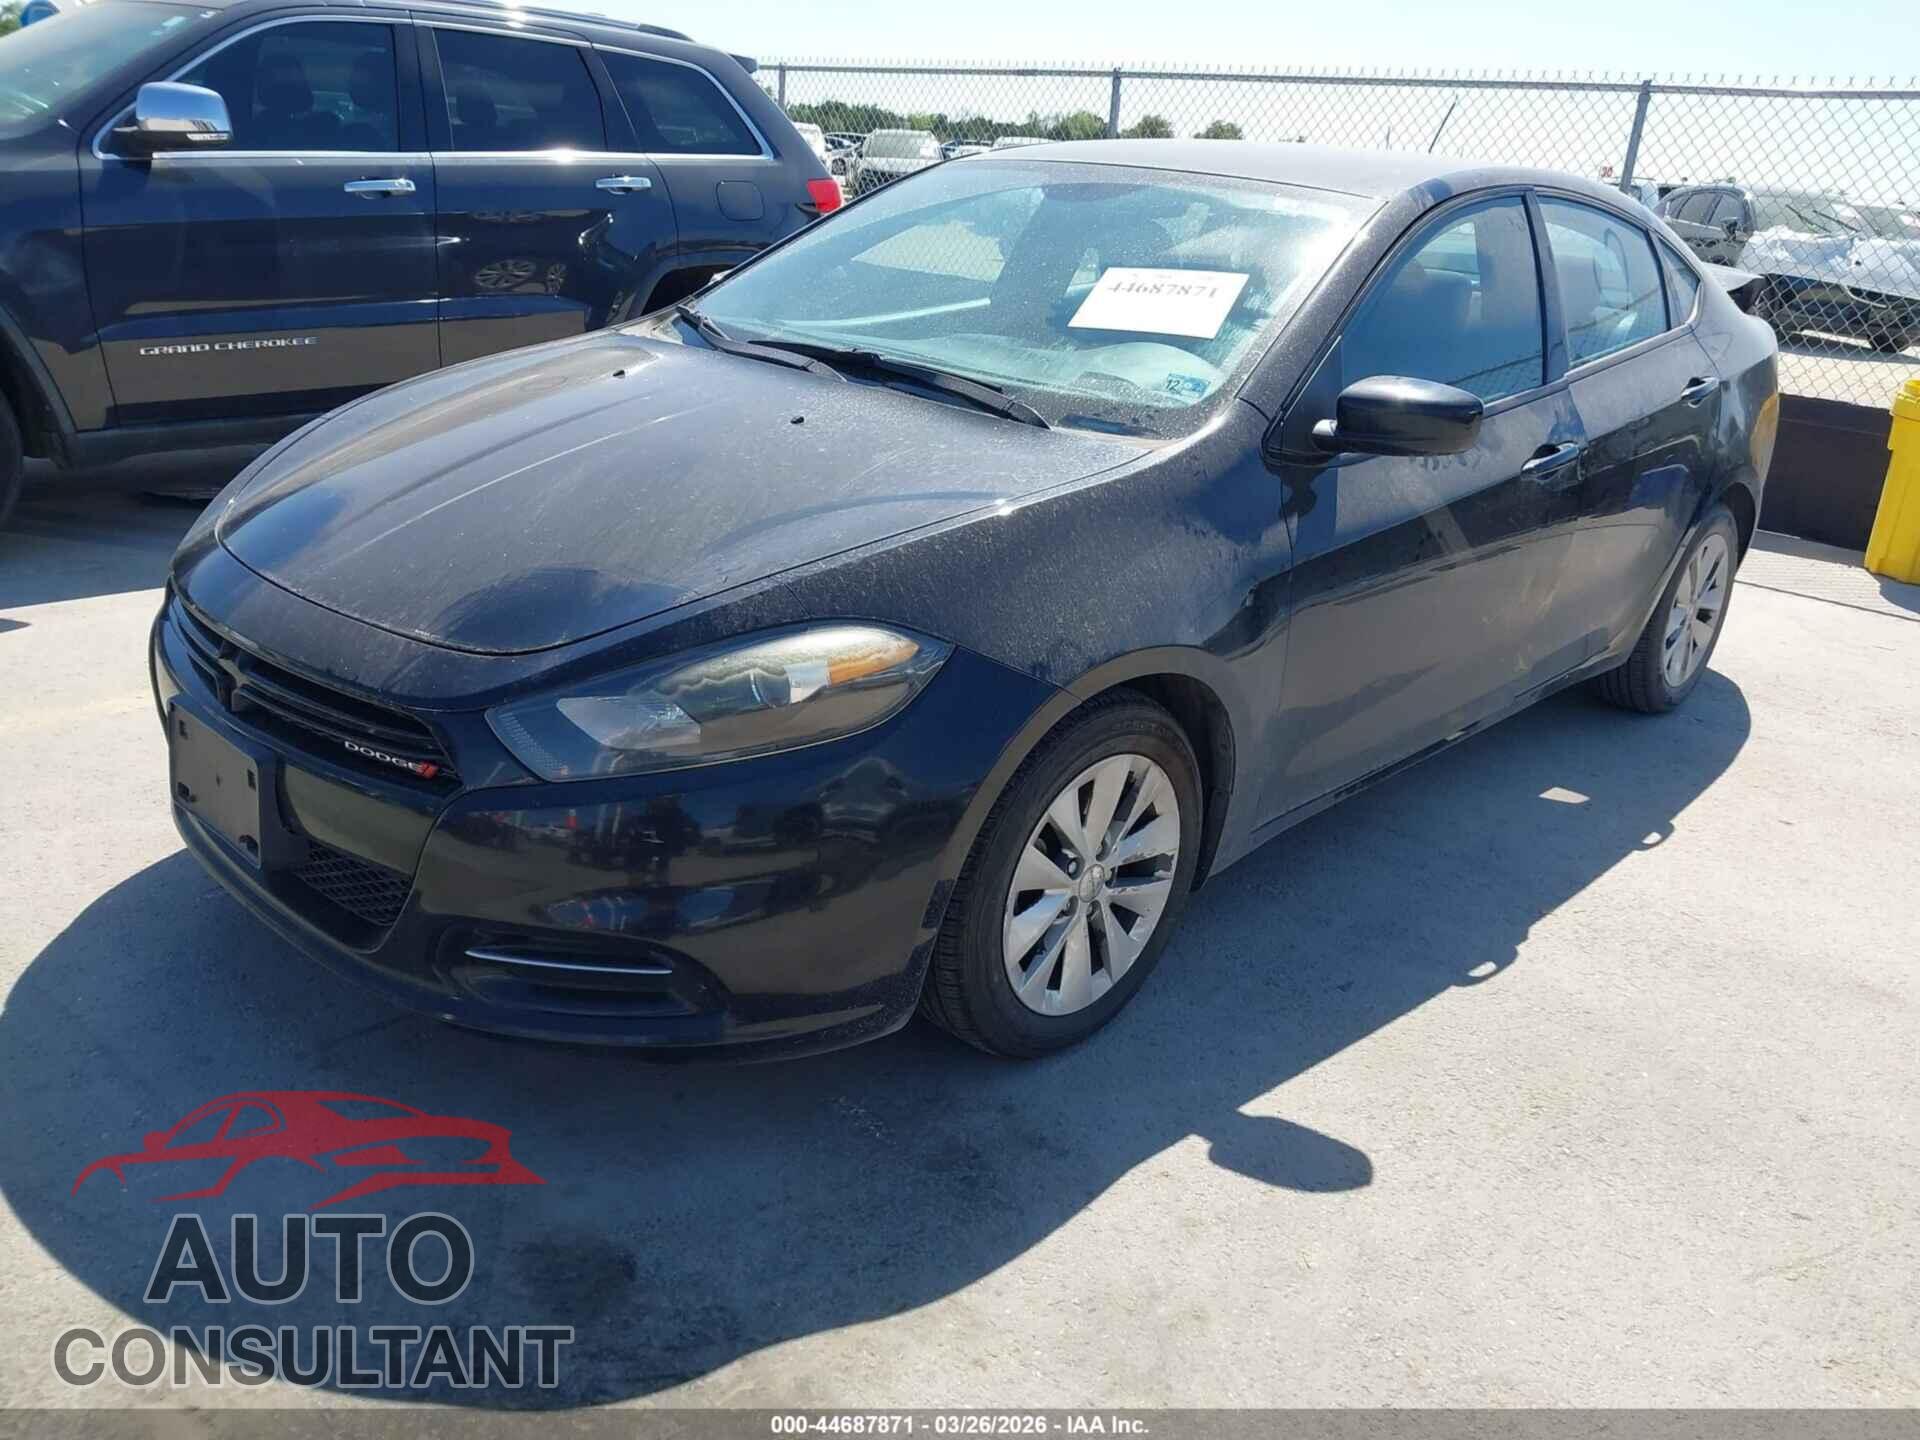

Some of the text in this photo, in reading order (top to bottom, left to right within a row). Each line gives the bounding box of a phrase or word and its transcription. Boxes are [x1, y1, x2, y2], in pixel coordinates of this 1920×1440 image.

[1106, 280, 1219, 299] 44687871
[139, 336, 320, 356] GRAND CHEROKEE
[344, 741, 422, 772] DODGE
